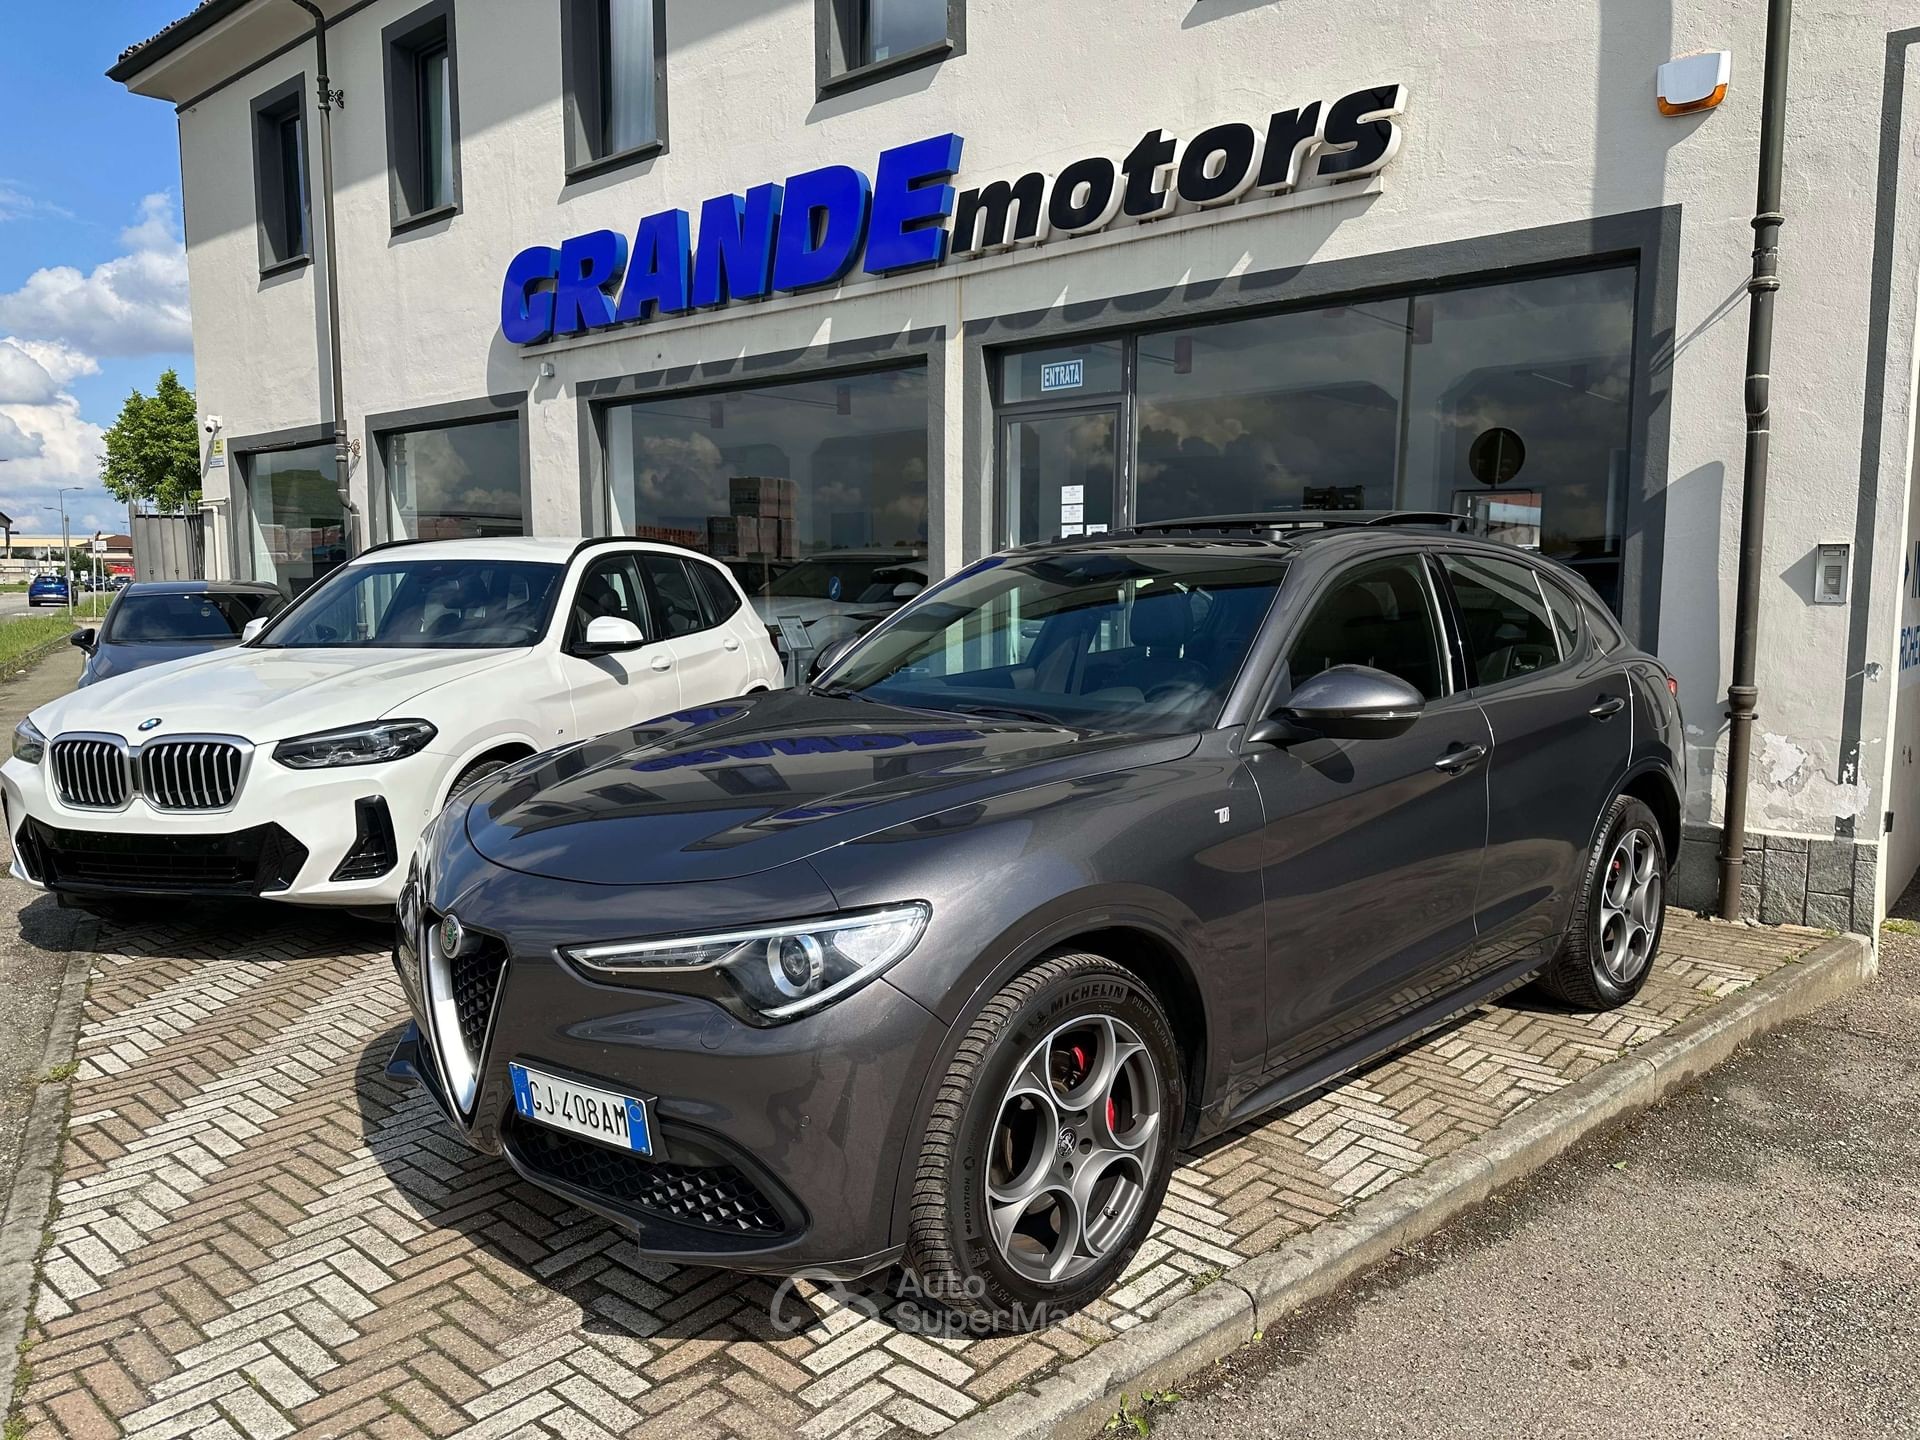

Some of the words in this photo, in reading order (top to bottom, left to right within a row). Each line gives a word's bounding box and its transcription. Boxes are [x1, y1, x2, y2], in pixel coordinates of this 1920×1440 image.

[501, 133, 963, 346] GRANDE
[952, 84, 1406, 259] motors
[1044, 364, 1080, 387] ENTRATA
[1050, 983, 1124, 1015] MICHELIN
[1131, 995, 1154, 1019] PILOT
[963, 1177, 971, 1225] ROTATION
